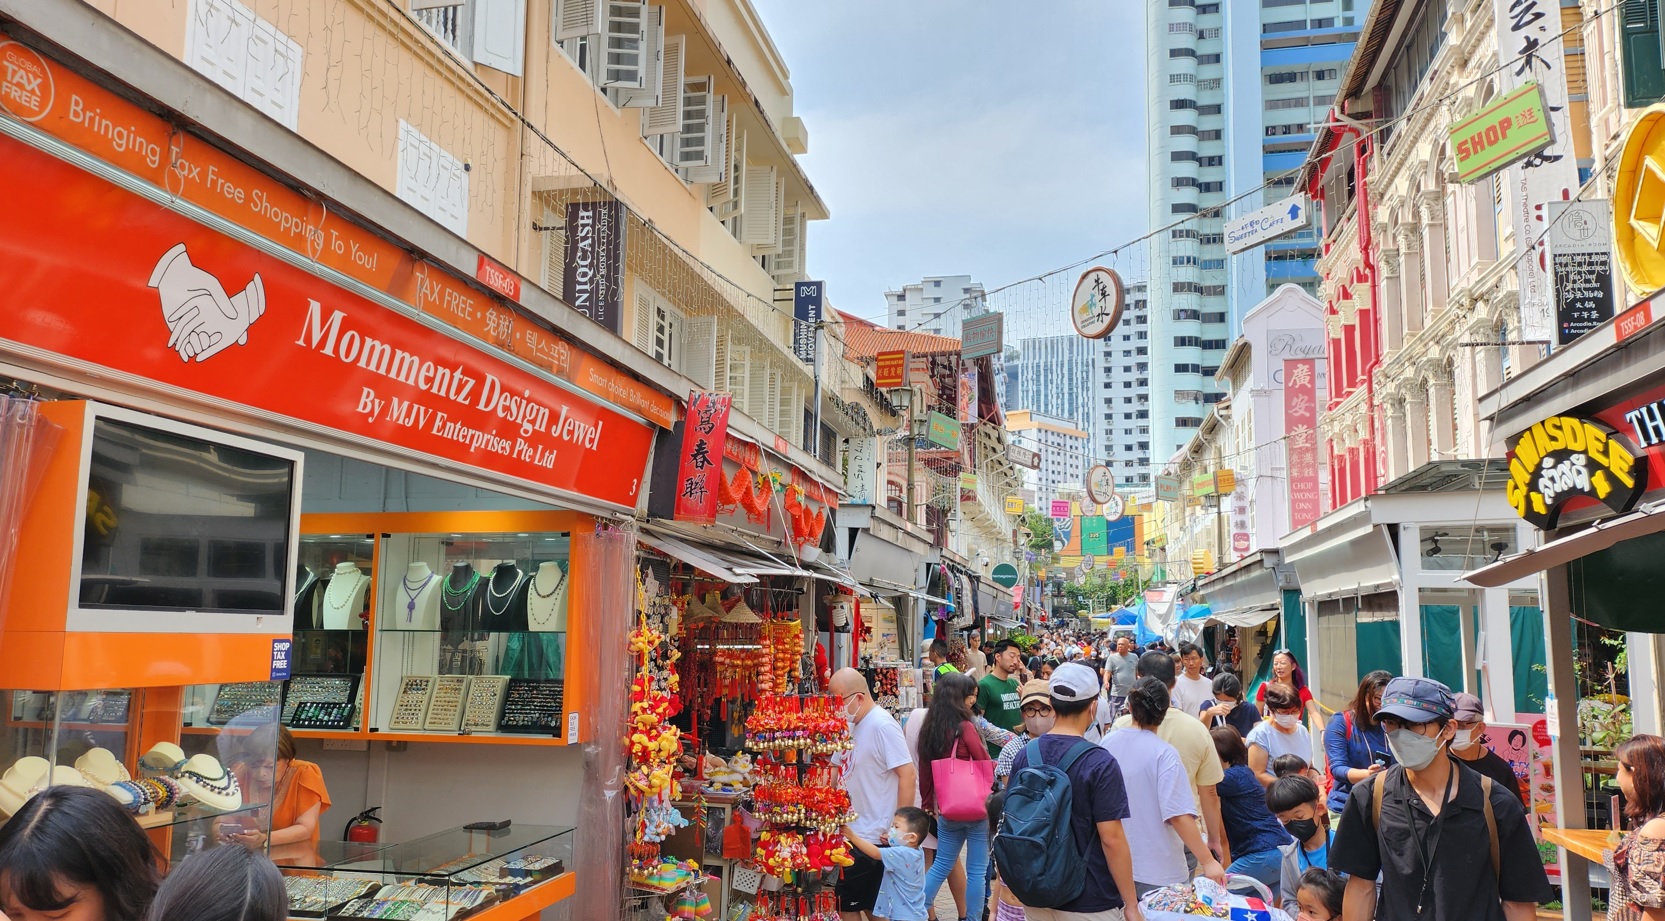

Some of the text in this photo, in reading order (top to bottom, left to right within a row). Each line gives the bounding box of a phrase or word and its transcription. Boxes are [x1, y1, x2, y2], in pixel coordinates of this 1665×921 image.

[3, 61, 43, 96] TAX
[6, 51, 43, 78] GLOBAL
[1, 81, 41, 111] FREE
[1456, 116, 1513, 162] SHOP
[68, 94, 378, 271] Bringing Tax Free Shopping To You!
[1520, 177, 1528, 193] TAS
[1521, 193, 1530, 223] Theatre
[1524, 223, 1531, 236] Co
[485, 263, 515, 296] TSSF-03
[416, 272, 474, 321] TAX FREE
[598, 279, 606, 320] LICENSED
[1571, 310, 1600, 319] 下午茶
[1620, 314, 1646, 336] TSSF-08
[808, 304, 816, 358] MOVEMENT
[525, 330, 571, 373] 텍스프리
[295, 298, 603, 451] Mommentz Design Jewel
[589, 367, 673, 421] Smart choice! Brilliant decision!
[1287, 364, 1314, 448] 廣安堂
[356, 387, 558, 469] By MJV Enterprises Pte Ltd
[1625, 400, 1665, 449] TH
[1506, 416, 1635, 518] SAWASDEE
[629, 479, 637, 496] 3
[1293, 482, 1313, 490] CHOP
[1294, 512, 1315, 520] TONG
[1296, 502, 1312, 510] ONN
[273, 642, 290, 651] SHOP
[273, 651, 286, 660] TAX
[272, 660, 288, 669] FREE
